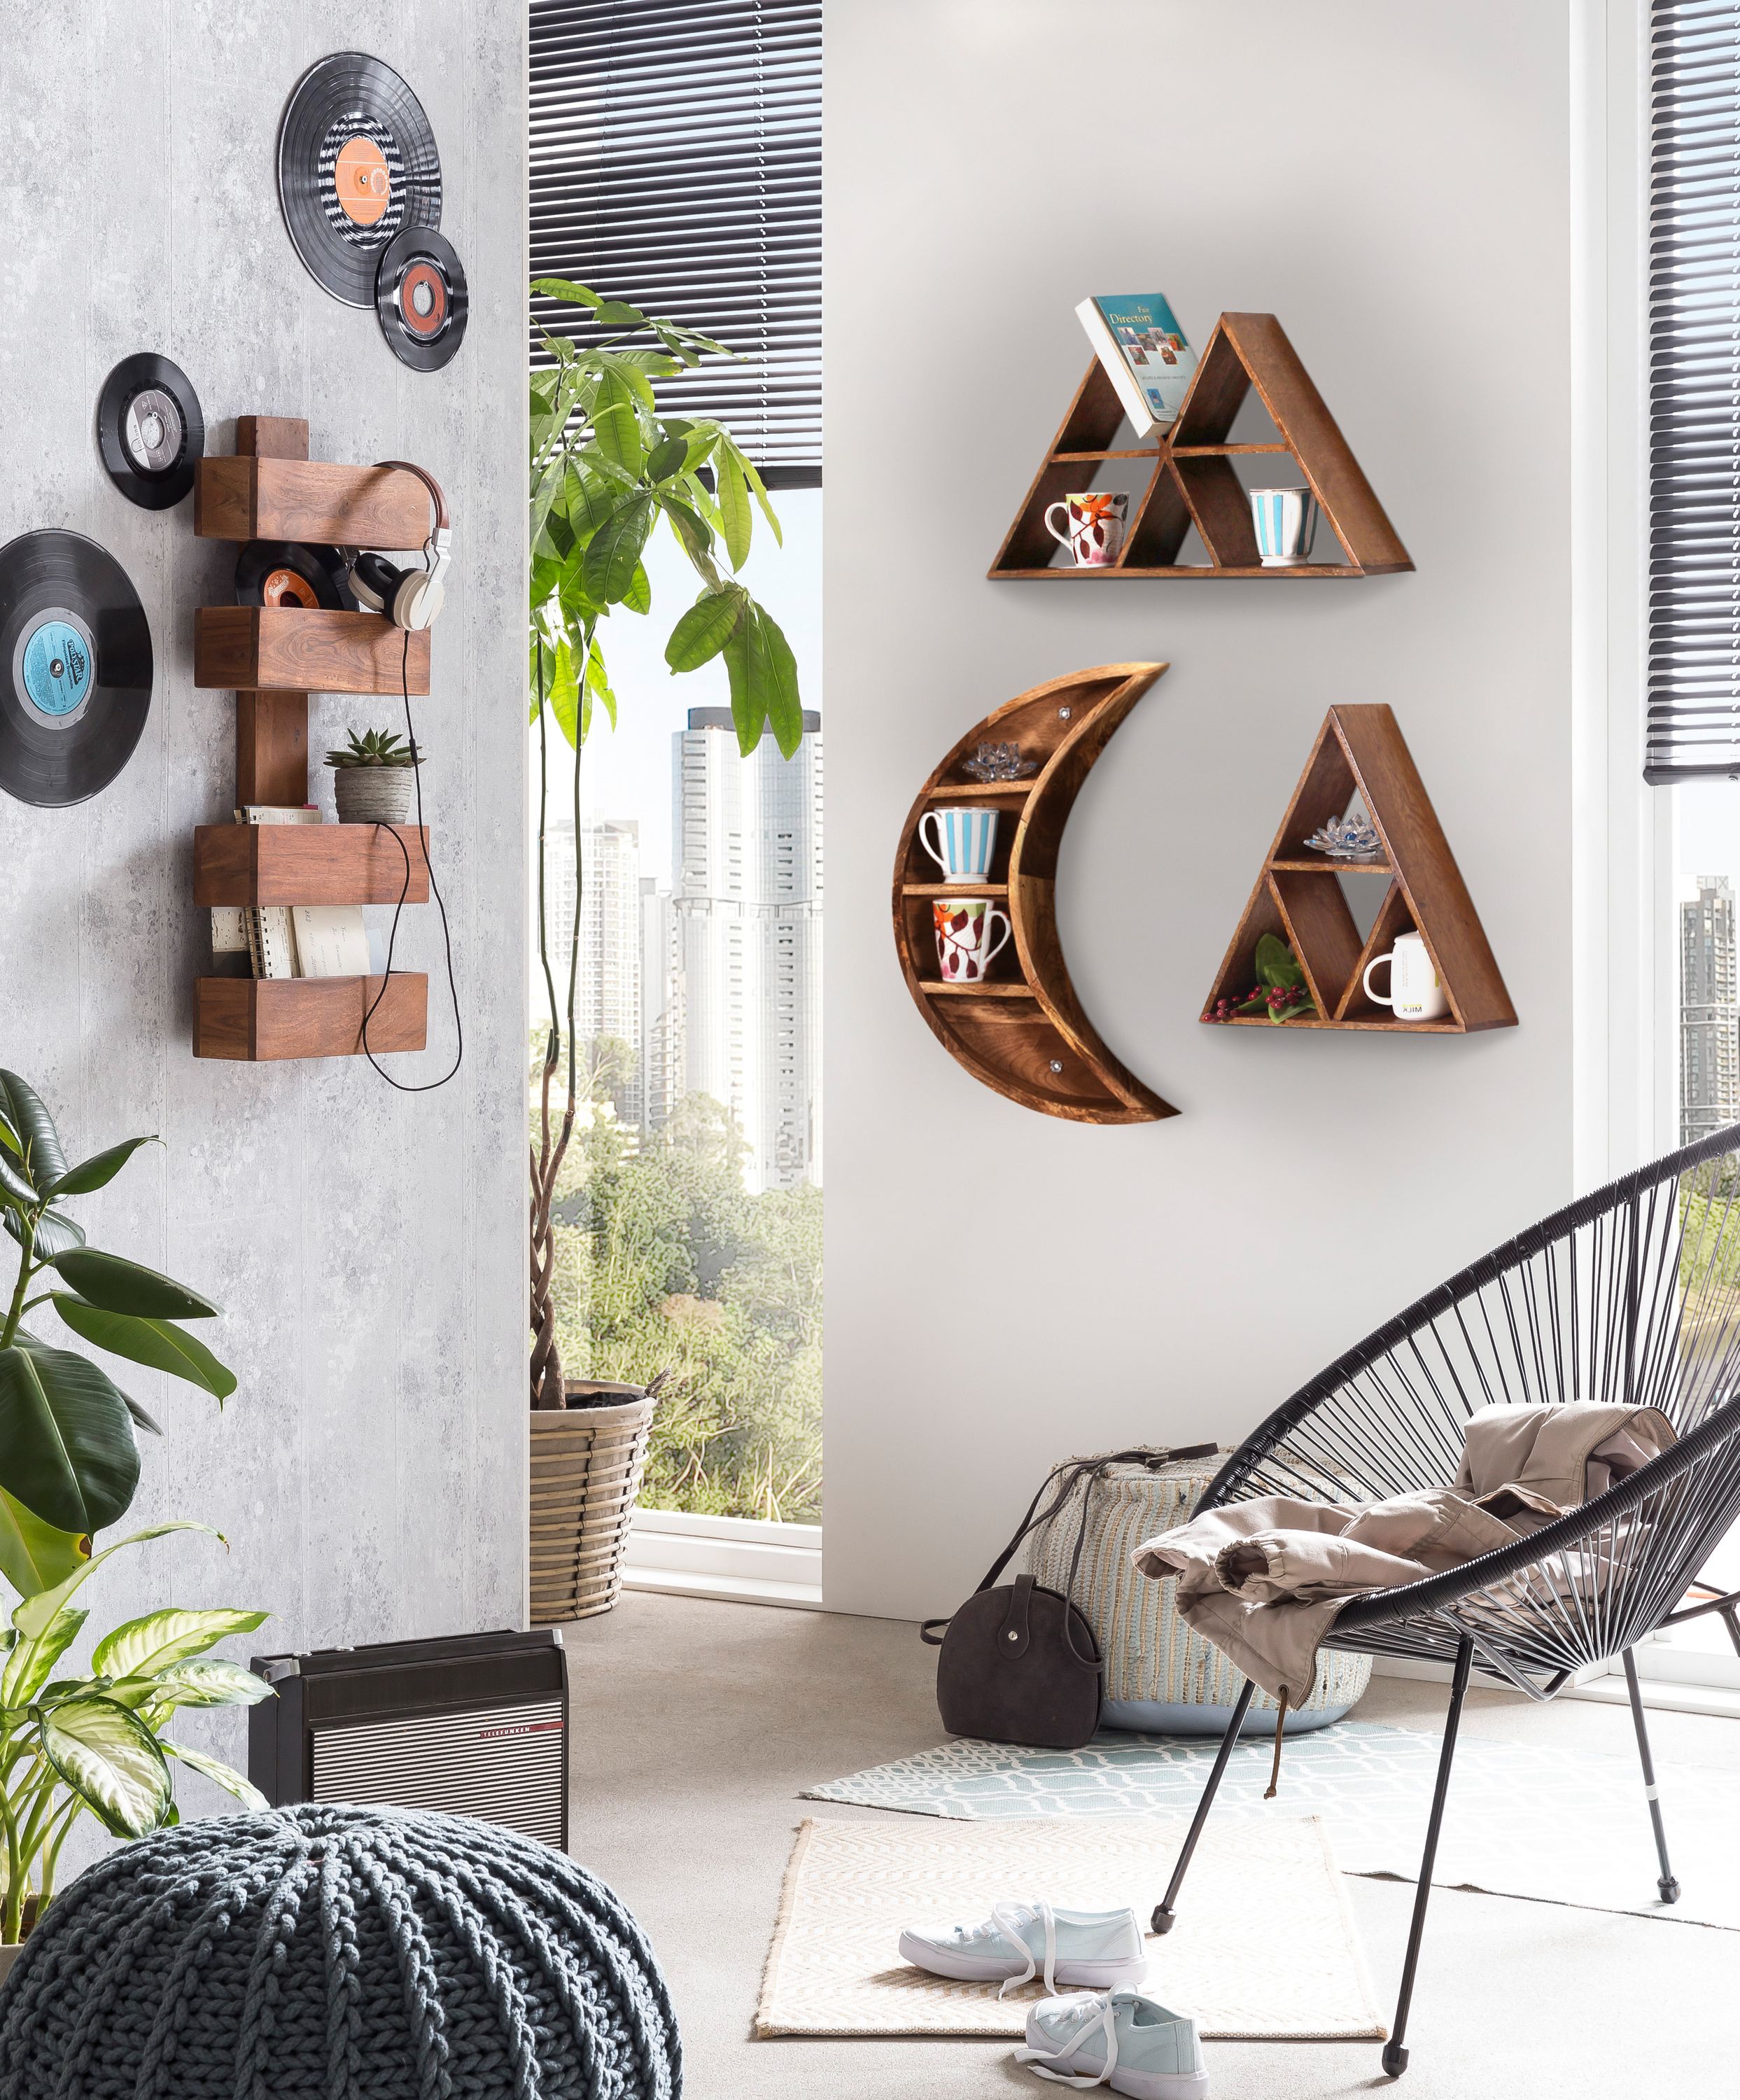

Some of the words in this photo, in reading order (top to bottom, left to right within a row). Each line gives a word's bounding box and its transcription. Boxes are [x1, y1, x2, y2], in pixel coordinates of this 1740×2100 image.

[1109, 313, 1153, 324] Directory
[68, 639, 83, 682] POLYSTAR
[484, 1727, 530, 1737] TELEFUNKEN
